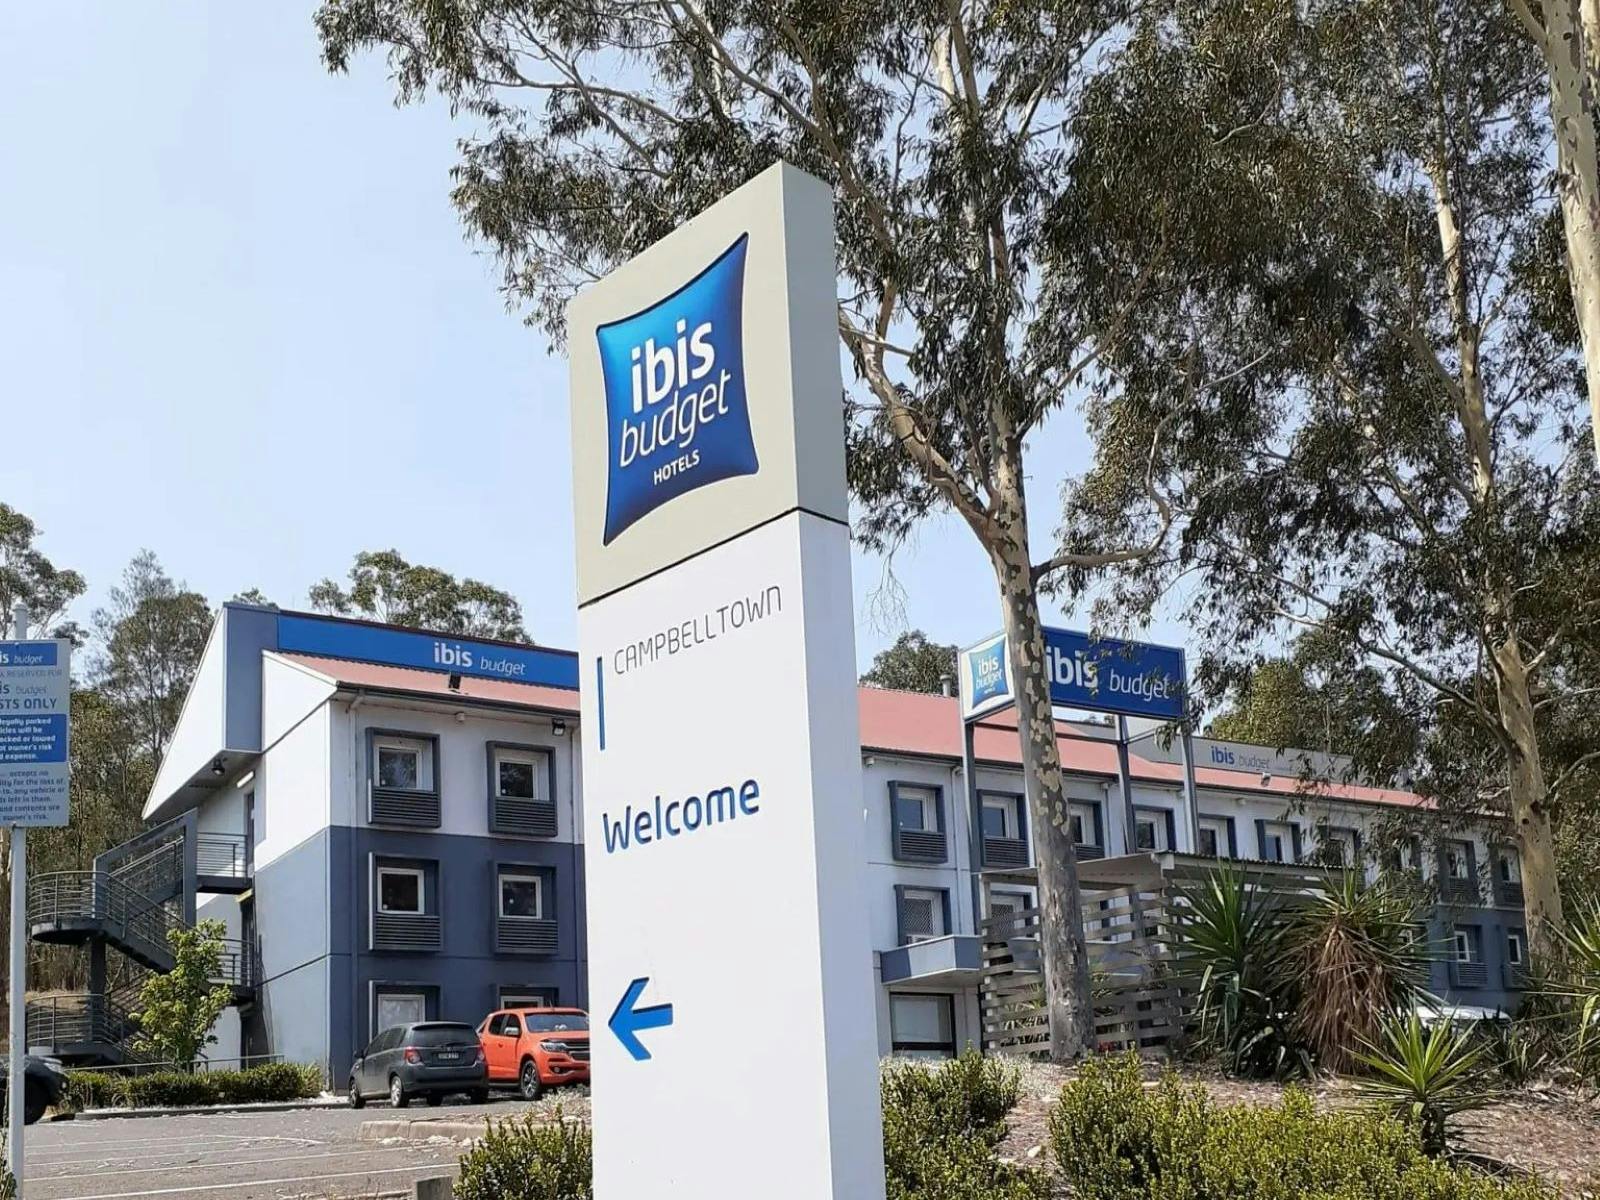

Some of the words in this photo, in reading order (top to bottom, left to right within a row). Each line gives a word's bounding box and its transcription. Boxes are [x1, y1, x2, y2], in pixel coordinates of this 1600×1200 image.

[631, 318, 715, 413] ibis
[620, 368, 731, 467] budget
[653, 449, 700, 485] HOTELS
[613, 585, 782, 675] CAMPBELLTOWN
[13, 654, 43, 665] budget
[434, 642, 473, 668] ibis
[480, 656, 526, 676] budget
[978, 655, 999, 677] ibis
[975, 668, 1003, 689] budget
[1045, 645, 1098, 688] ibis
[1109, 668, 1170, 702] budget
[15, 685, 47, 696] budget
[24, 697, 57, 709] ONLY
[25, 717, 51, 726] parked
[32, 734, 56, 742] towed
[1210, 745, 1235, 765] ibis
[1238, 754, 1270, 771] budget
[602, 779, 760, 854] Welcome
